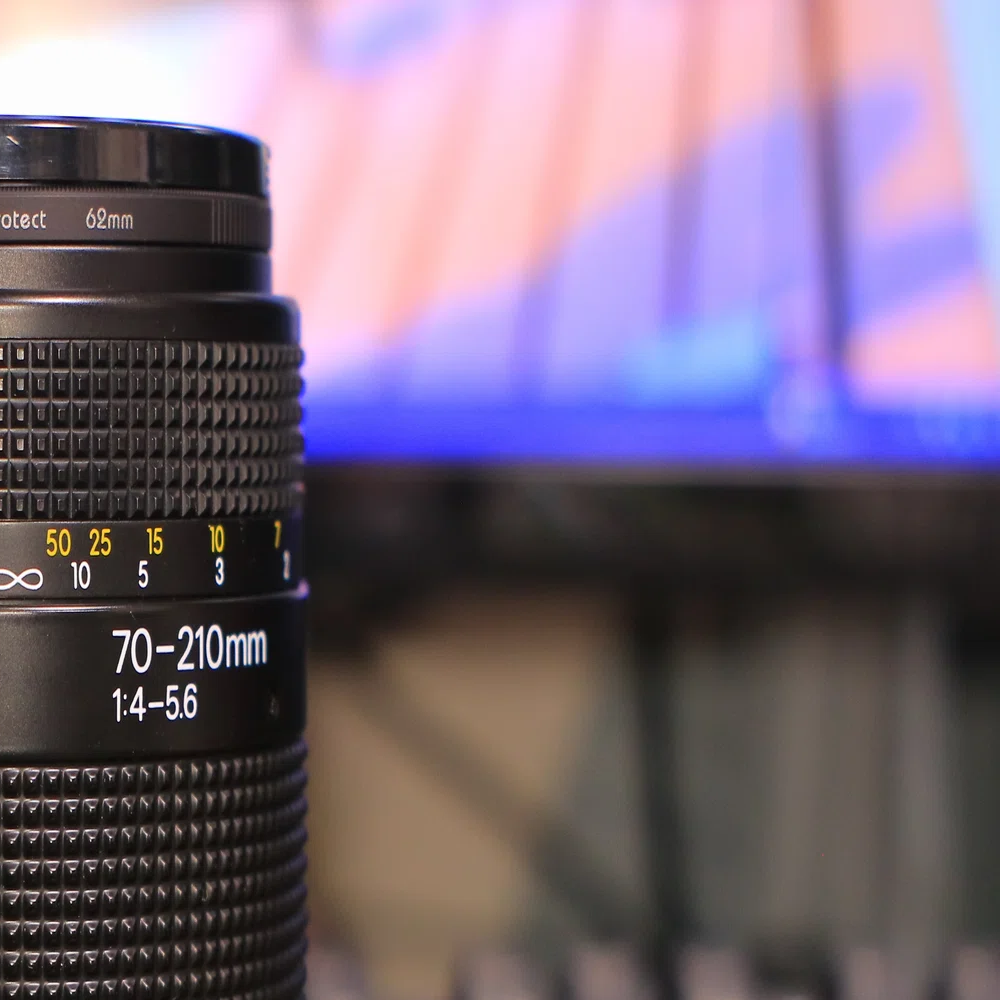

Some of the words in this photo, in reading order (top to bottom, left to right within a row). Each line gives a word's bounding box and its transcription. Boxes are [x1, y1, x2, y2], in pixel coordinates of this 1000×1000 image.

[85, 207, 133, 230] 62mm
[46, 527, 72, 557] 50
[89, 528, 112, 556] 25
[146, 527, 164, 555] 15
[208, 524, 225, 553] 10
[70, 560, 91, 590] 10
[138, 559, 149, 589] 5
[215, 556, 225, 586] 3
[112, 624, 267, 674] 70-210mm
[112, 682, 198, 723] 1:4-5.6
